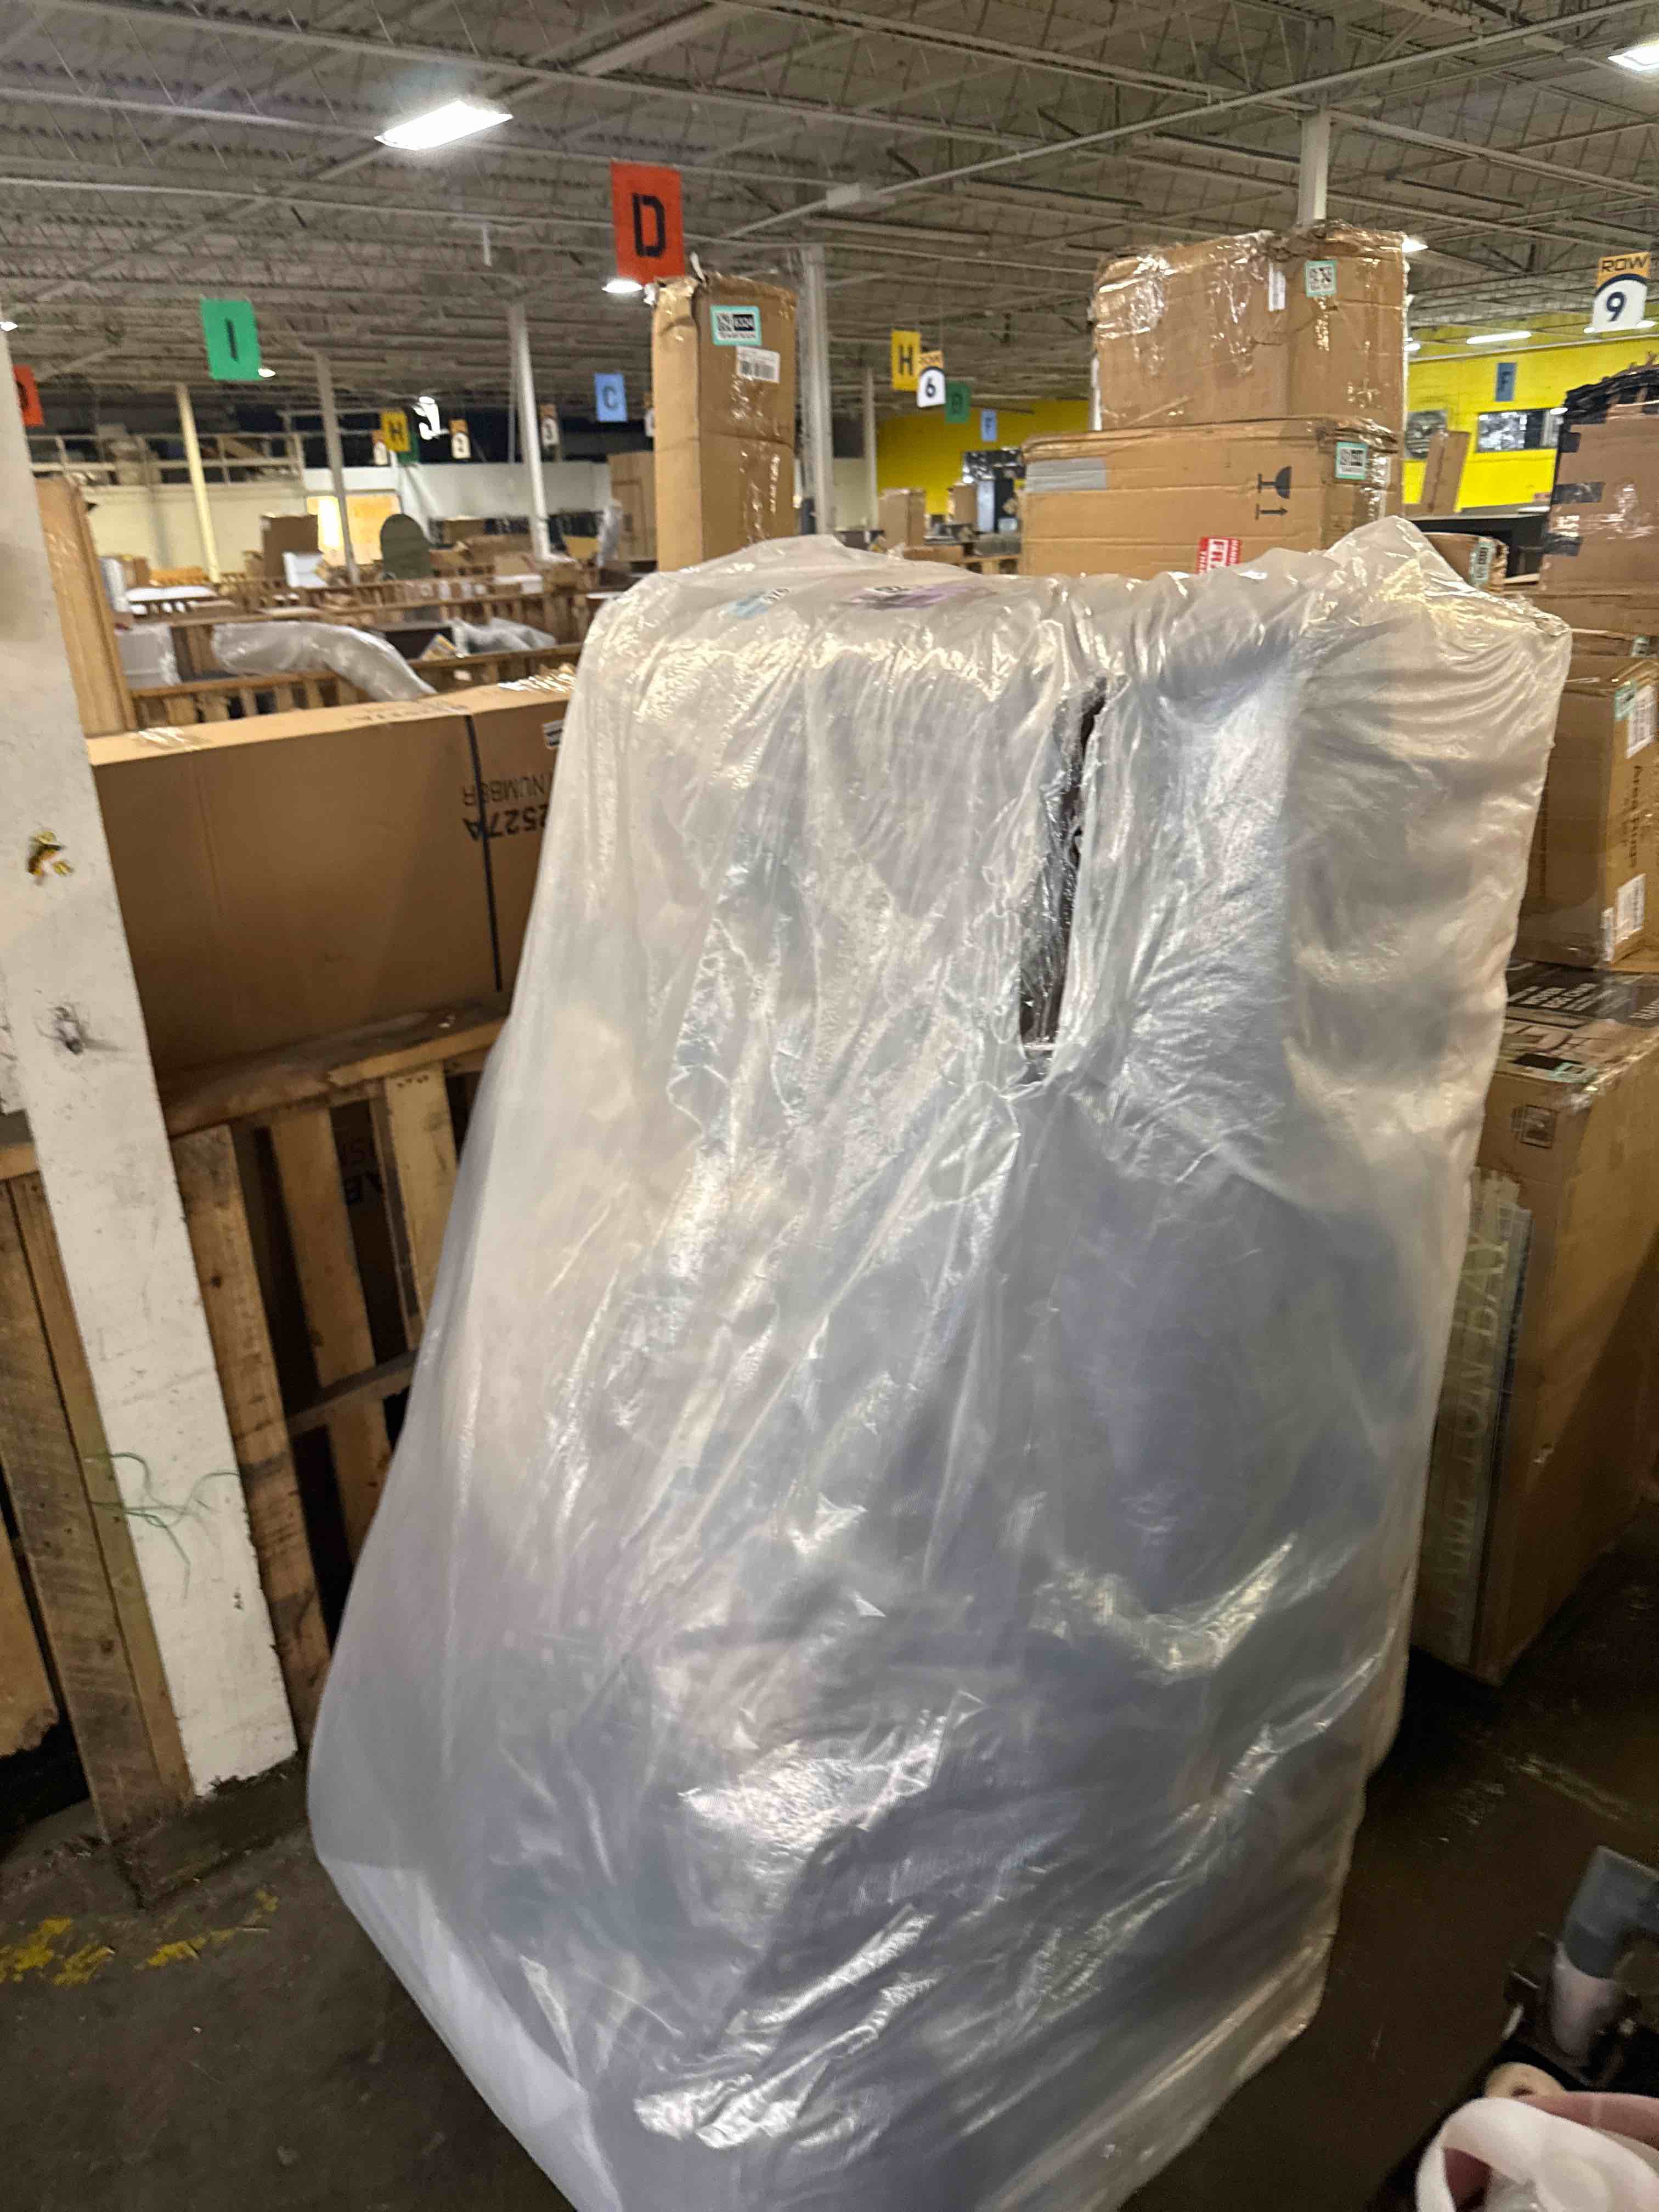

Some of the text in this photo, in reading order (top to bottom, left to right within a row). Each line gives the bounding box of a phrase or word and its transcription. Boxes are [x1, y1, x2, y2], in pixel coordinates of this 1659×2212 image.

[632, 193, 665, 257] D
[1601, 256, 1647, 272] ROW
[1606, 292, 1627, 321] 9
[899, 344, 913, 376] H
[603, 386, 617, 410] C
[926, 377, 936, 398] 6
[388, 421, 404, 443] H
[1229, 539, 1238, 563] HAND
